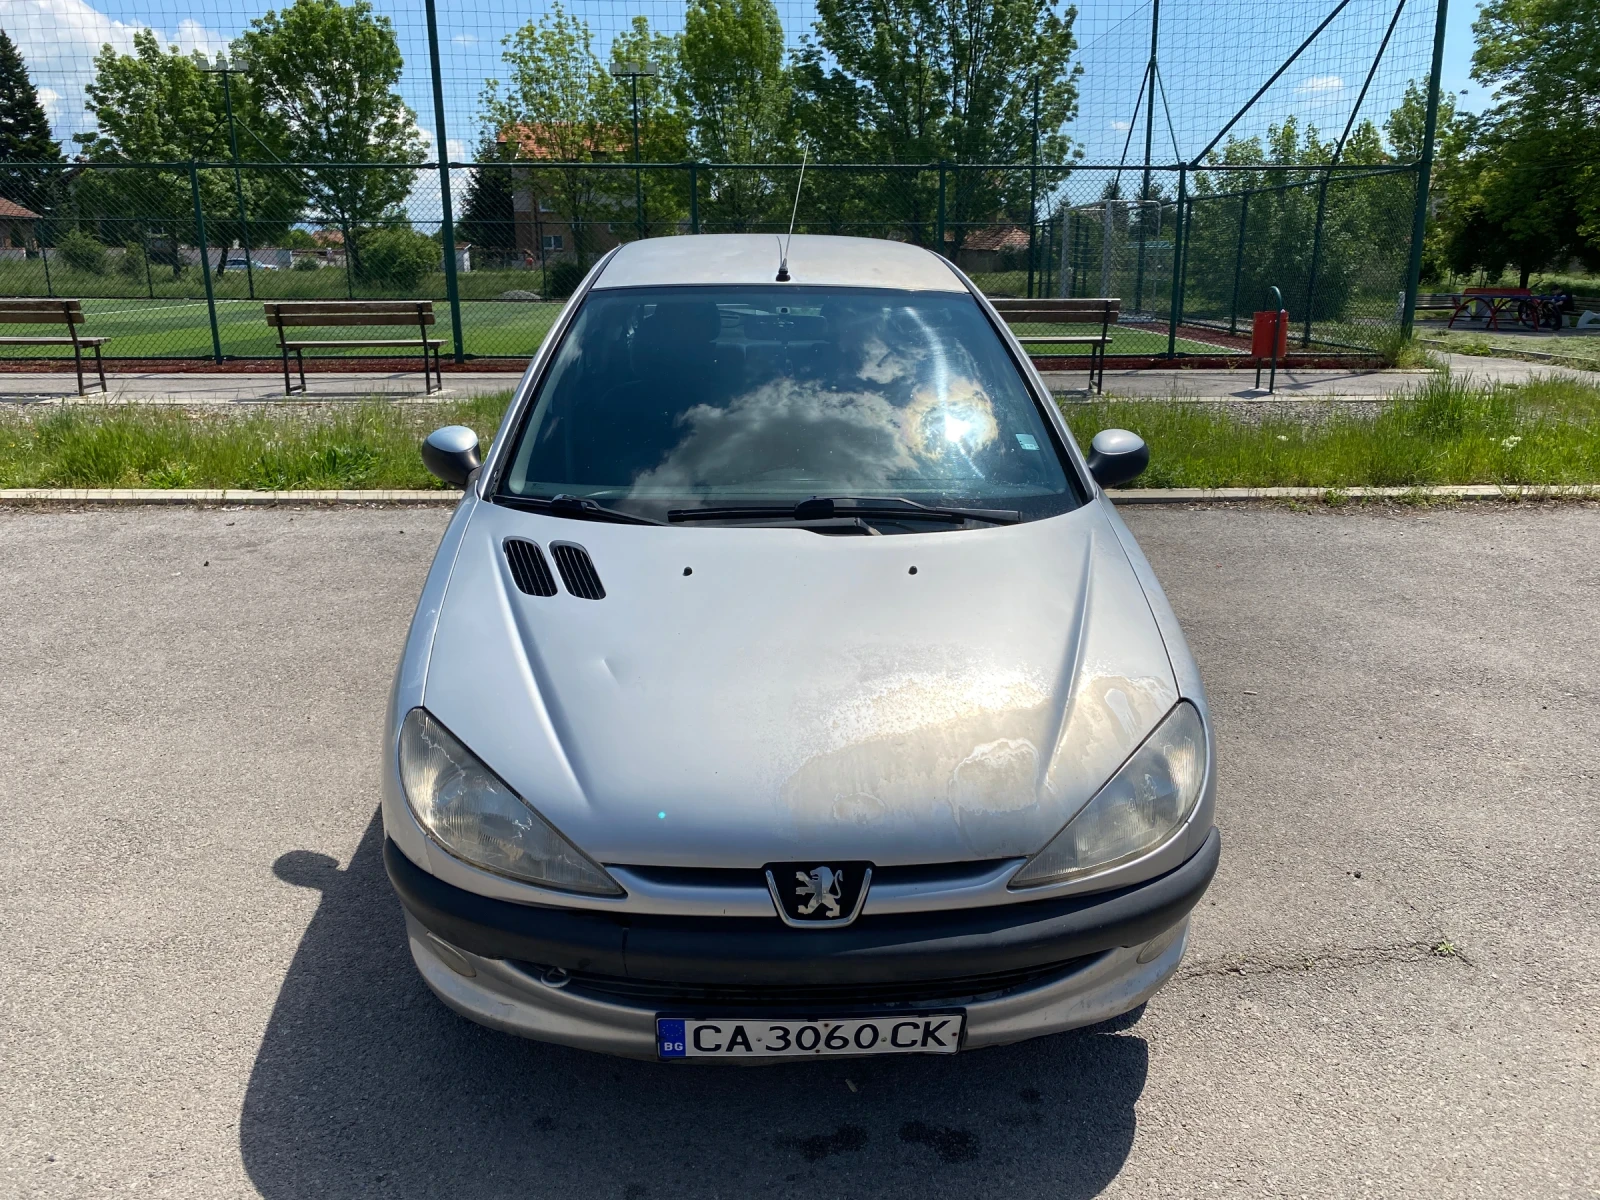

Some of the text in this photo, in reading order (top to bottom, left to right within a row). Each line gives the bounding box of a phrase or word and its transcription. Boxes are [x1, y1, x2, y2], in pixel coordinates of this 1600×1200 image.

[693, 1020, 951, 1052] CA 3060 CK
[664, 1043, 683, 1051] BG
